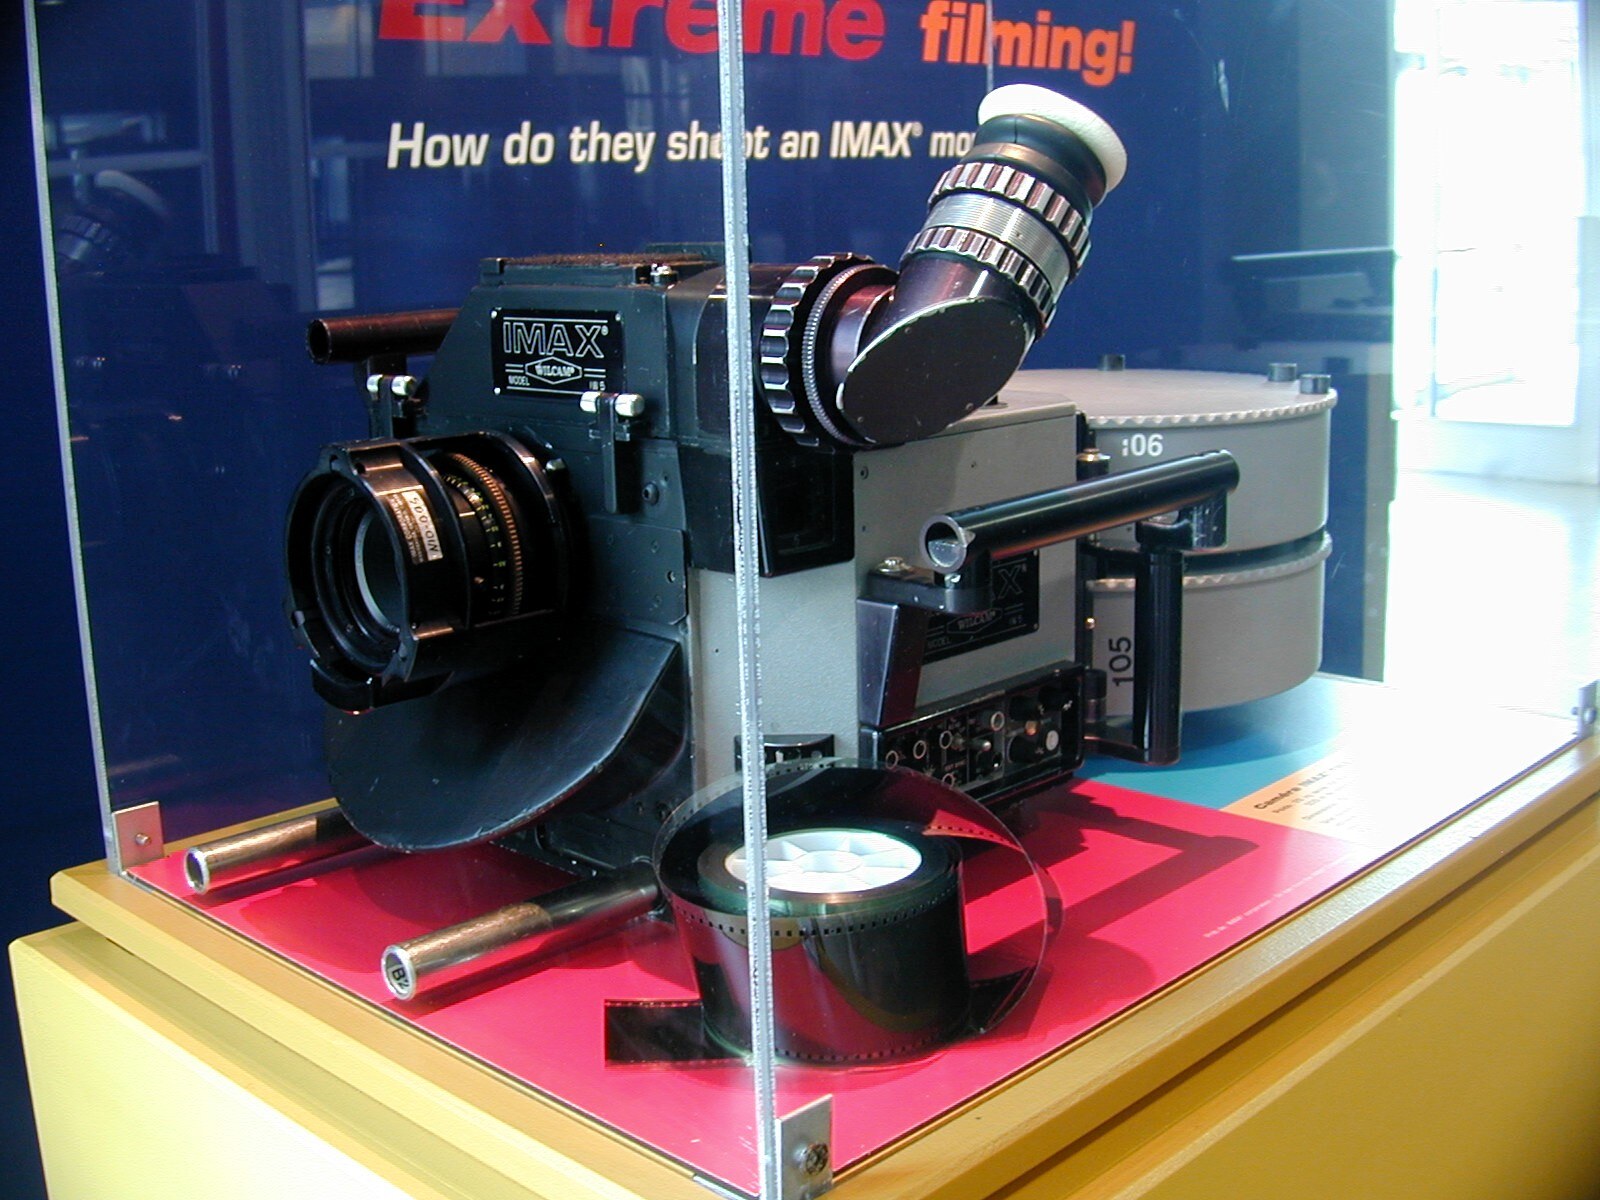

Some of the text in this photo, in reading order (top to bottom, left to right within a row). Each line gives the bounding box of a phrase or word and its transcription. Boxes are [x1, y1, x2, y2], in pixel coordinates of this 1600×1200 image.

[920, 0, 1136, 87] filming!
[387, 121, 489, 169] How
[503, 120, 555, 165] do
[569, 120, 656, 174] they
[666, 120, 770, 161] shot
[779, 130, 820, 159] an
[1108, 636, 1134, 687] 105
